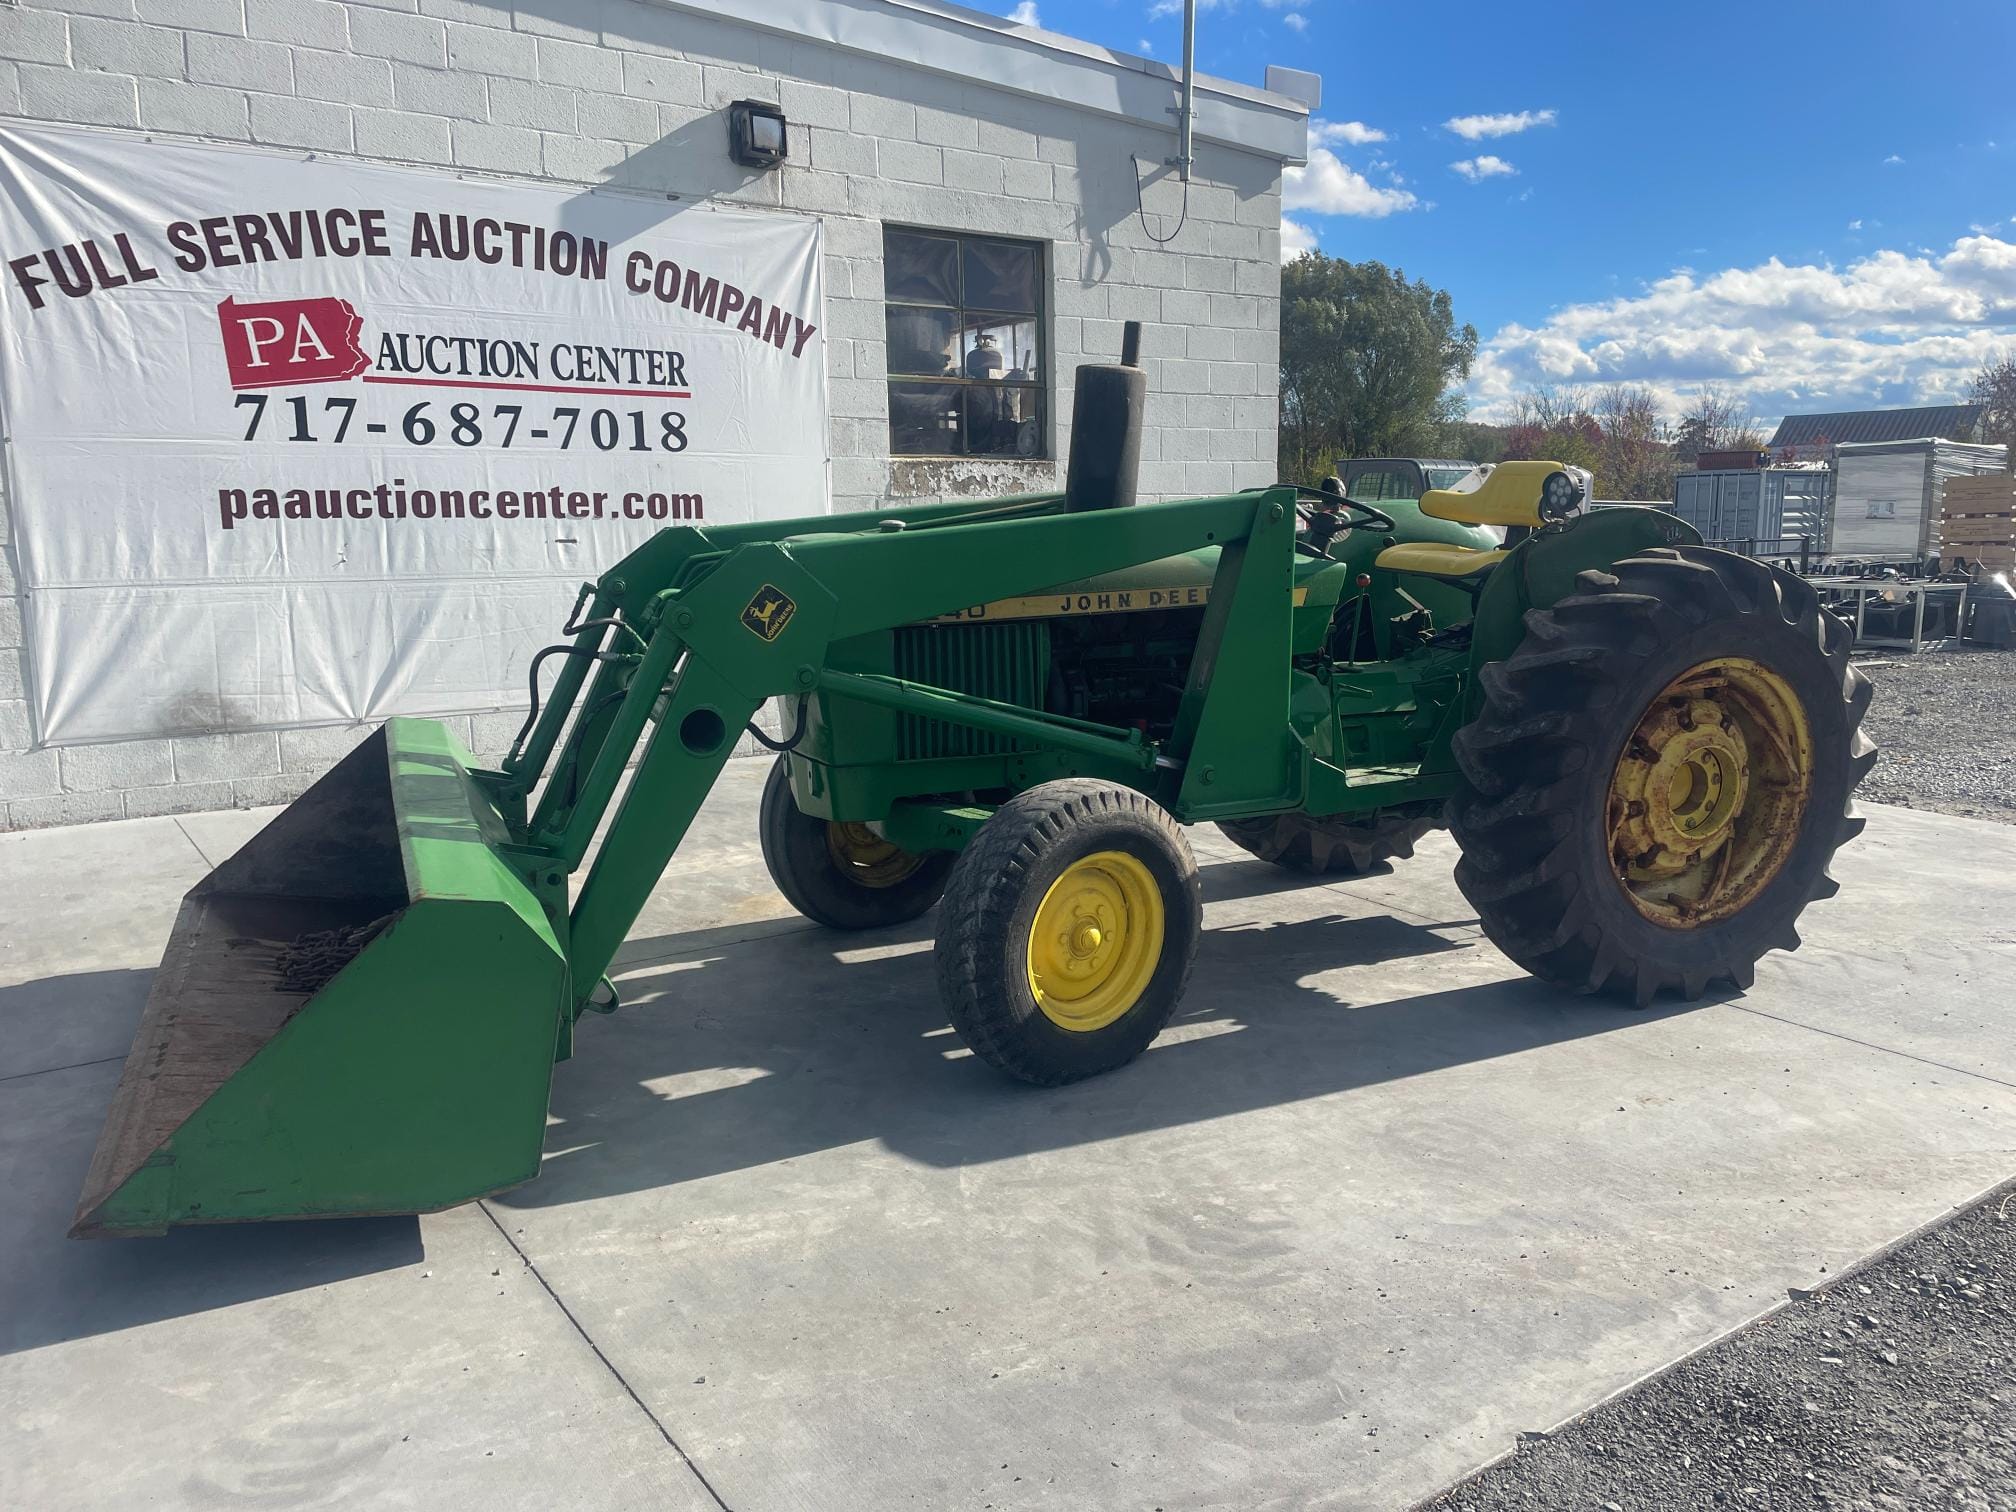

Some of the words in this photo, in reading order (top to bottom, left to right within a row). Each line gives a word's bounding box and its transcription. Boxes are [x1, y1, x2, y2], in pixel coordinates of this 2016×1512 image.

[8, 233, 158, 310] FULL
[167, 208, 392, 273] SERVICE
[411, 211, 608, 280] AUCTION
[625, 250, 817, 359] COMPANY
[237, 312, 335, 368] PA
[375, 331, 539, 379] AUCTION
[550, 343, 689, 387] CENTER
[233, 394, 689, 453] 717-687-7018
[218, 478, 705, 530] paauctioncenter.com
[1060, 592, 1132, 612] JOHN
